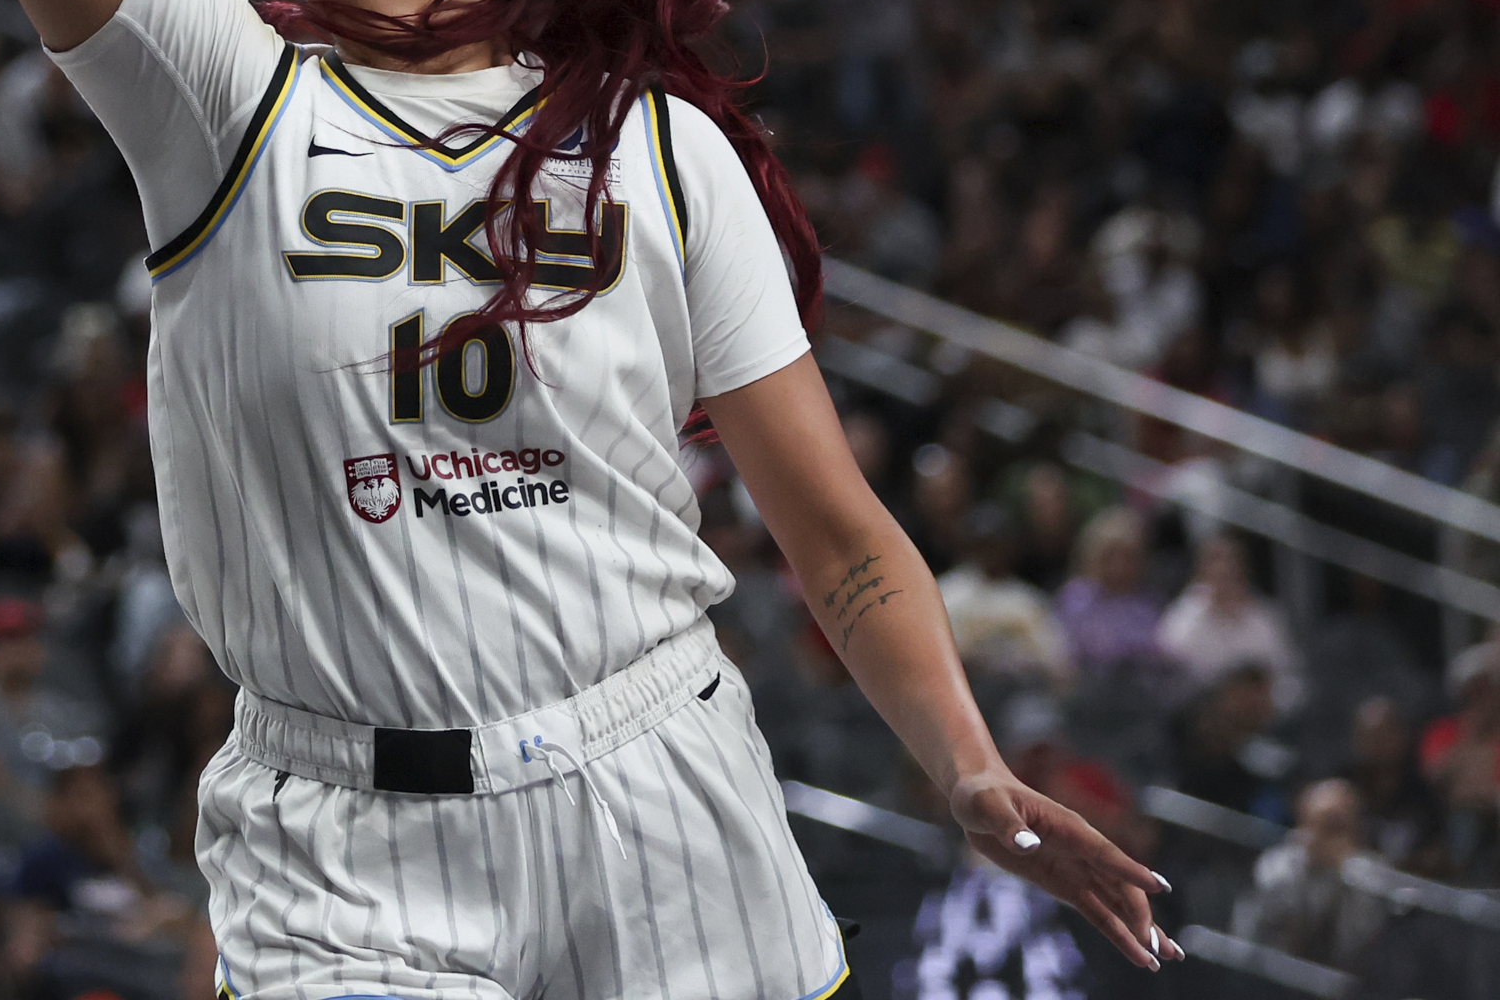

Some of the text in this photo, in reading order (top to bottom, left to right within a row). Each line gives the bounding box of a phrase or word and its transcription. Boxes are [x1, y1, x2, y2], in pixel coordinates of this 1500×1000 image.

[281, 187, 630, 298] SKY
[389, 307, 517, 425] 10
[407, 445, 566, 482] UChicago
[414, 475, 570, 519] Medicine
